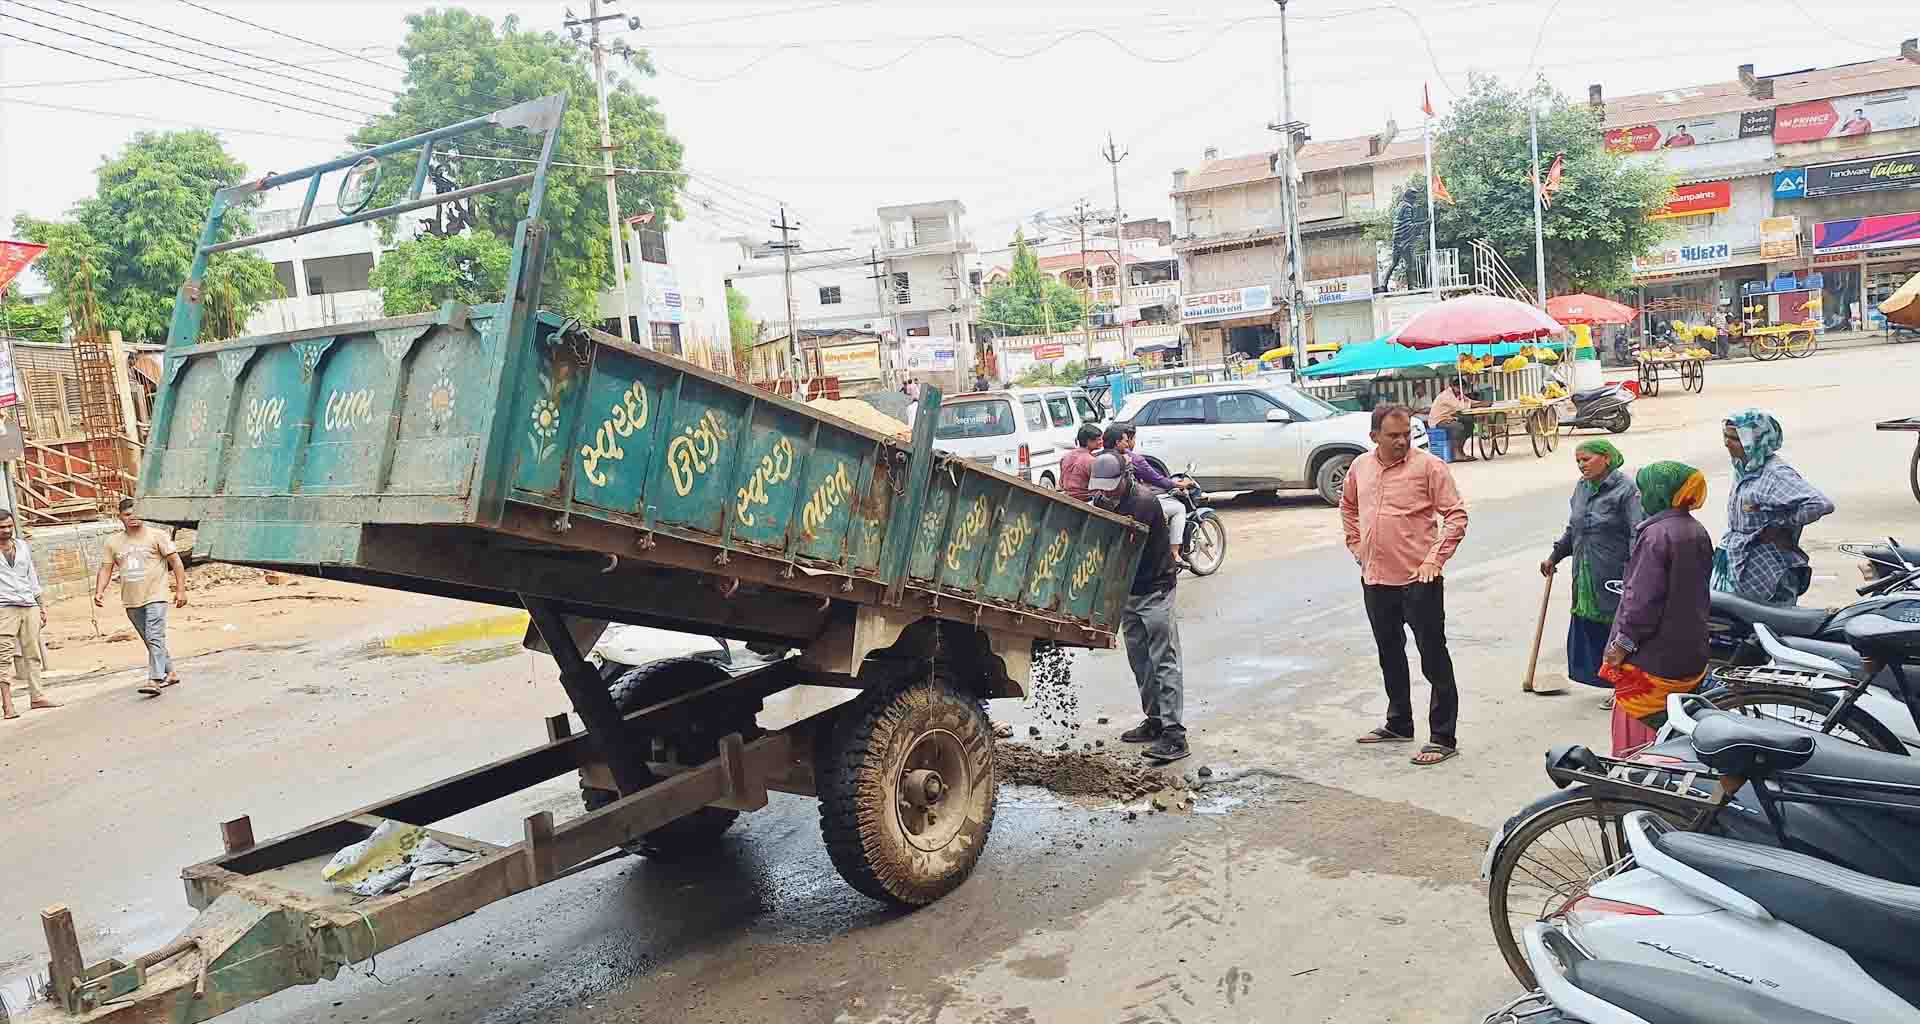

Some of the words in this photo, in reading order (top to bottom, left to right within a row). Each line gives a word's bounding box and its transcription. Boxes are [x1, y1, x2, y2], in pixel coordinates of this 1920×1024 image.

[1793, 114, 1829, 125] PRINCE
[1830, 167, 1870, 179] hindware
[1870, 160, 1917, 179] italian
